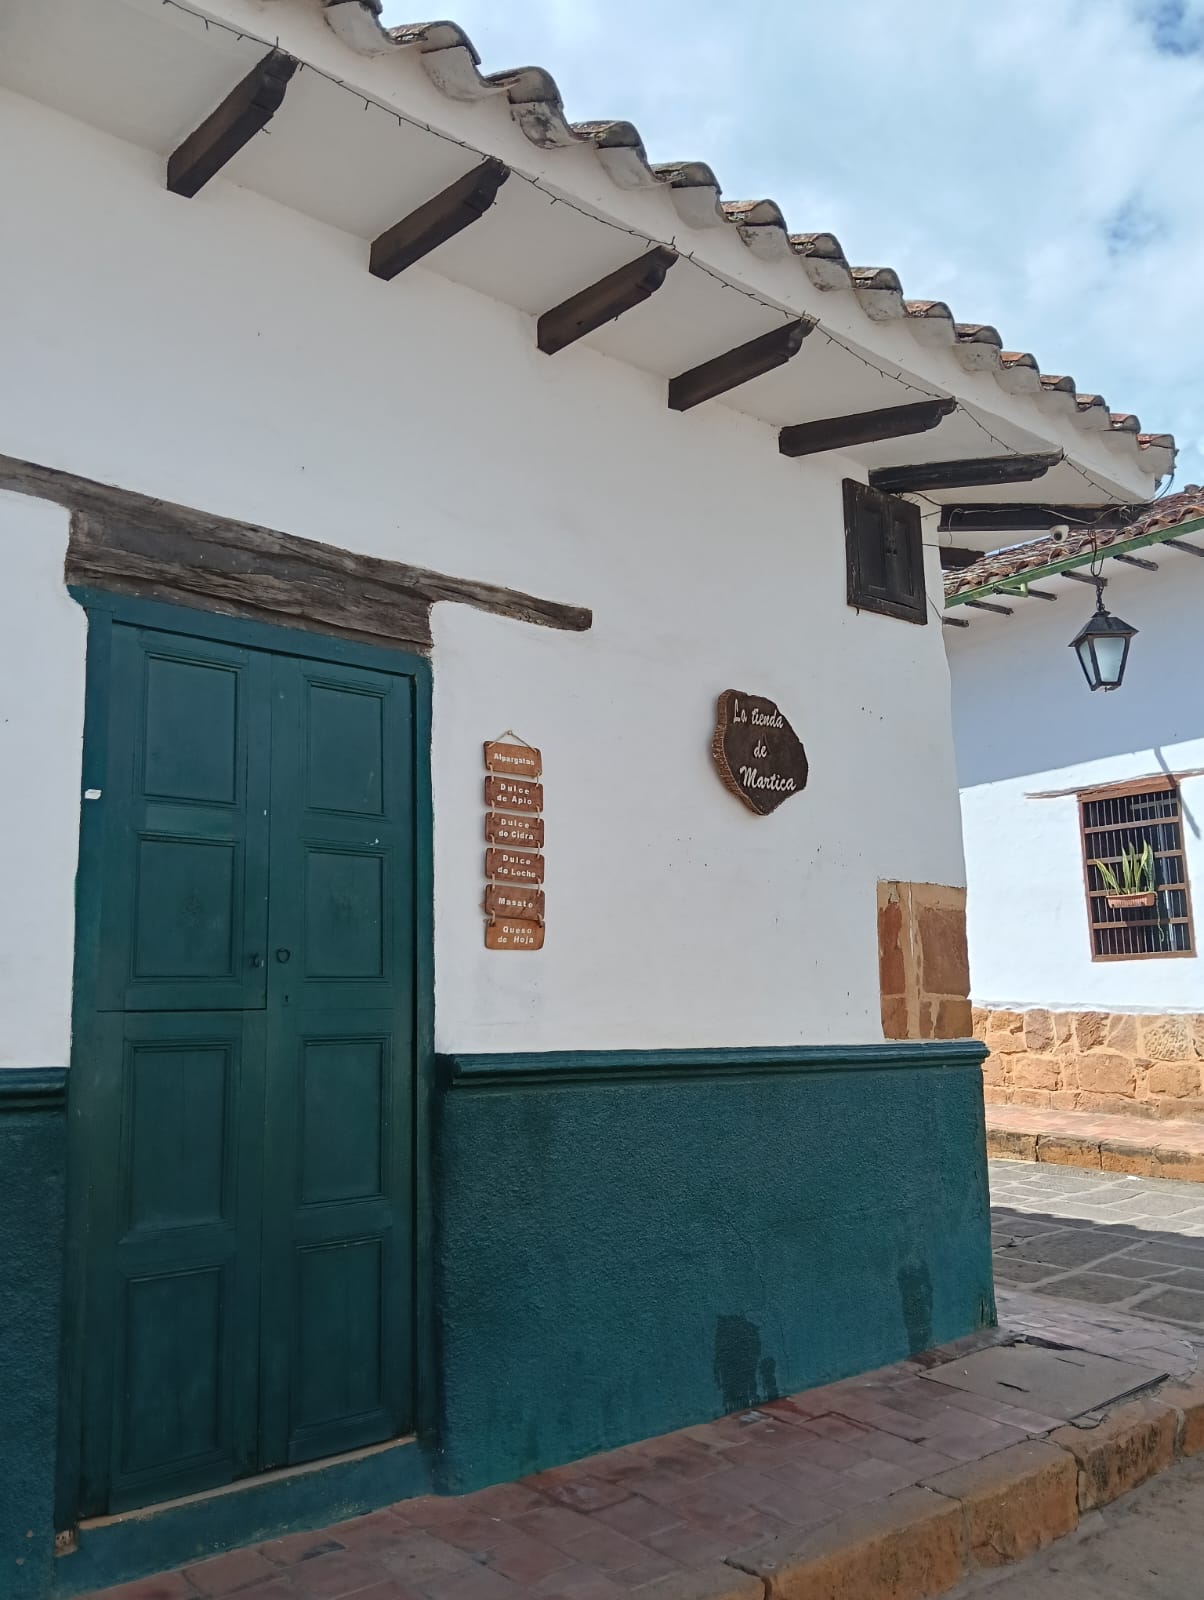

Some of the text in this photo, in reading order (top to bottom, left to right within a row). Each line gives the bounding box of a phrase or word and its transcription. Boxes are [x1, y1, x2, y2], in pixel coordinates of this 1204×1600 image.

[733, 698, 784, 729] La tienda
[753, 739, 768, 758] de
[739, 765, 797, 791] Martica
[500, 783, 530, 795] Dulce
[496, 794, 508, 802] de
[501, 818, 530, 829] Dulce
[502, 854, 531, 865] Dulce
[498, 897, 533, 909] Masato
[502, 926, 532, 934] Queso
[513, 936, 534, 944] Hoja
